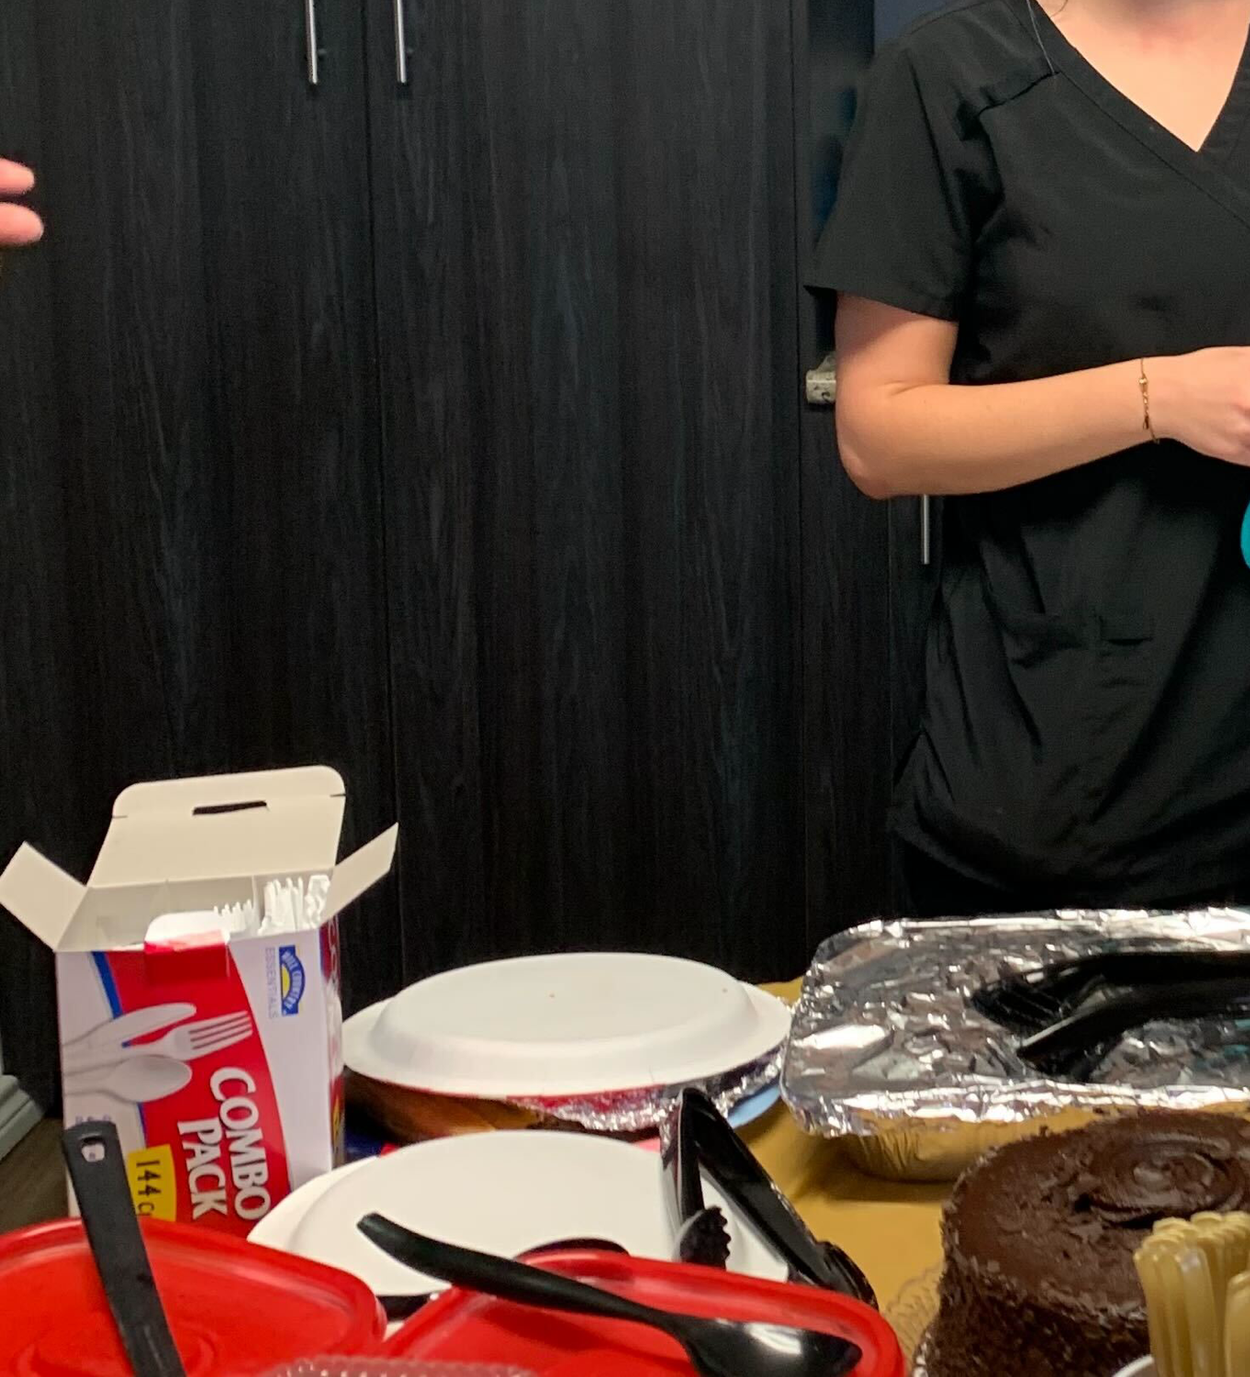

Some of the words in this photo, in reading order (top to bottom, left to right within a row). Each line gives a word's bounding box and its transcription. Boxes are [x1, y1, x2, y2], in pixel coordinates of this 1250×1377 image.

[136, 1160, 162, 1197] 144
[177, 1116, 229, 1221] PACK
[210, 1066, 272, 1221] COMBO
